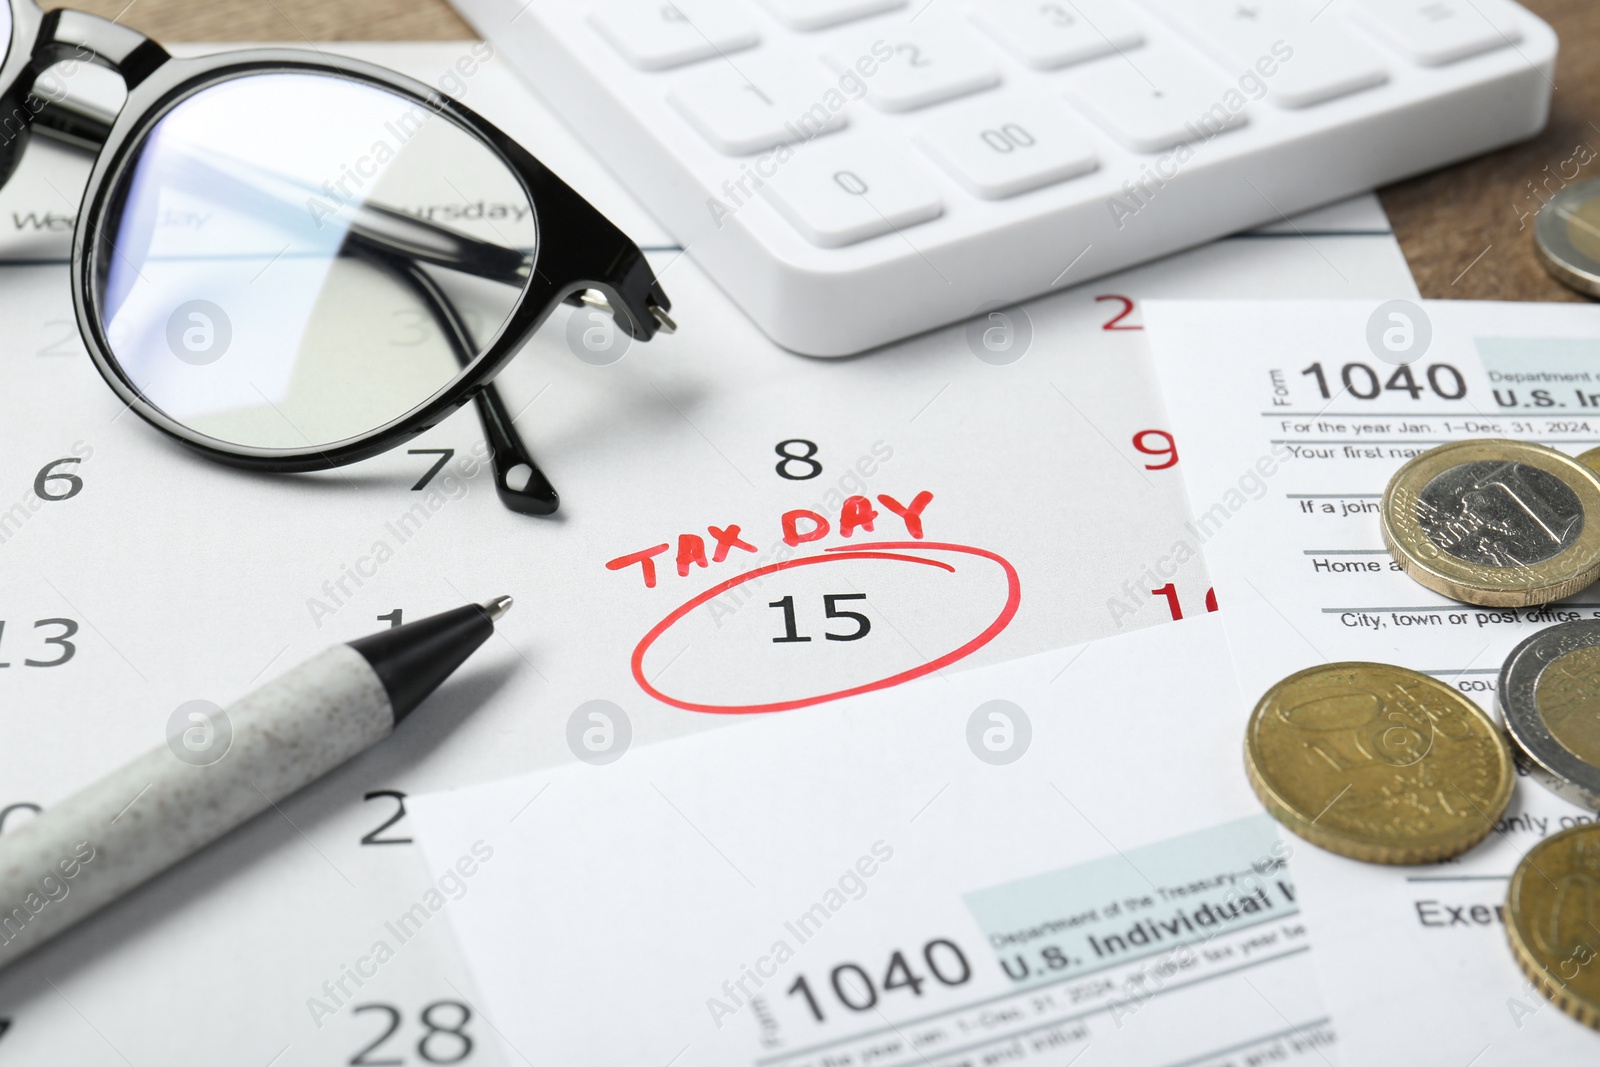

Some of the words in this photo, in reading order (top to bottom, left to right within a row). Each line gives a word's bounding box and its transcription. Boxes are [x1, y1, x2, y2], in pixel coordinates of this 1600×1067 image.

[1039, 4, 1076, 28] 3
[895, 42, 931, 68] 2
[743, 83, 774, 107] 1
[980, 123, 1036, 154] 00
[833, 170, 868, 195] 0
[1094, 295, 1144, 330] 2
[1269, 369, 1292, 407] Form
[1302, 362, 1468, 400] 1040
[1488, 370, 1586, 387] Department
[1491, 388, 1567, 408] U.S.
[1282, 421, 1313, 434] For
[1318, 421, 1348, 434] the
[1353, 423, 1393, 438] year
[1398, 421, 1438, 434] Jan.
[1512, 421, 1542, 435] 31,
[1546, 421, 1598, 435] 2024,
[774, 439, 823, 480] 8
[1132, 429, 1179, 471] 9
[1288, 445, 1340, 459] Your
[1345, 446, 1384, 459] first
[33, 457, 84, 502] 6
[407, 448, 456, 491] 7
[1300, 500, 1315, 514] If
[1320, 503, 1336, 514] a
[1341, 500, 1381, 517] join
[605, 524, 758, 589] TAX
[782, 491, 934, 547] DAY
[1313, 559, 1381, 573] Home
[768, 593, 872, 643] 15
[1151, 583, 1220, 621] 1
[1340, 613, 1387, 630] City,
[1391, 612, 1443, 627] town
[1449, 612, 1469, 625] or
[1476, 611, 1522, 628] post
[360, 790, 414, 845] 2
[1497, 813, 1547, 837] only
[1000, 945, 1082, 983] U.S.
[1088, 889, 1276, 958] Individual
[787, 937, 973, 1023] 1040
[347, 1000, 474, 1067] 28
